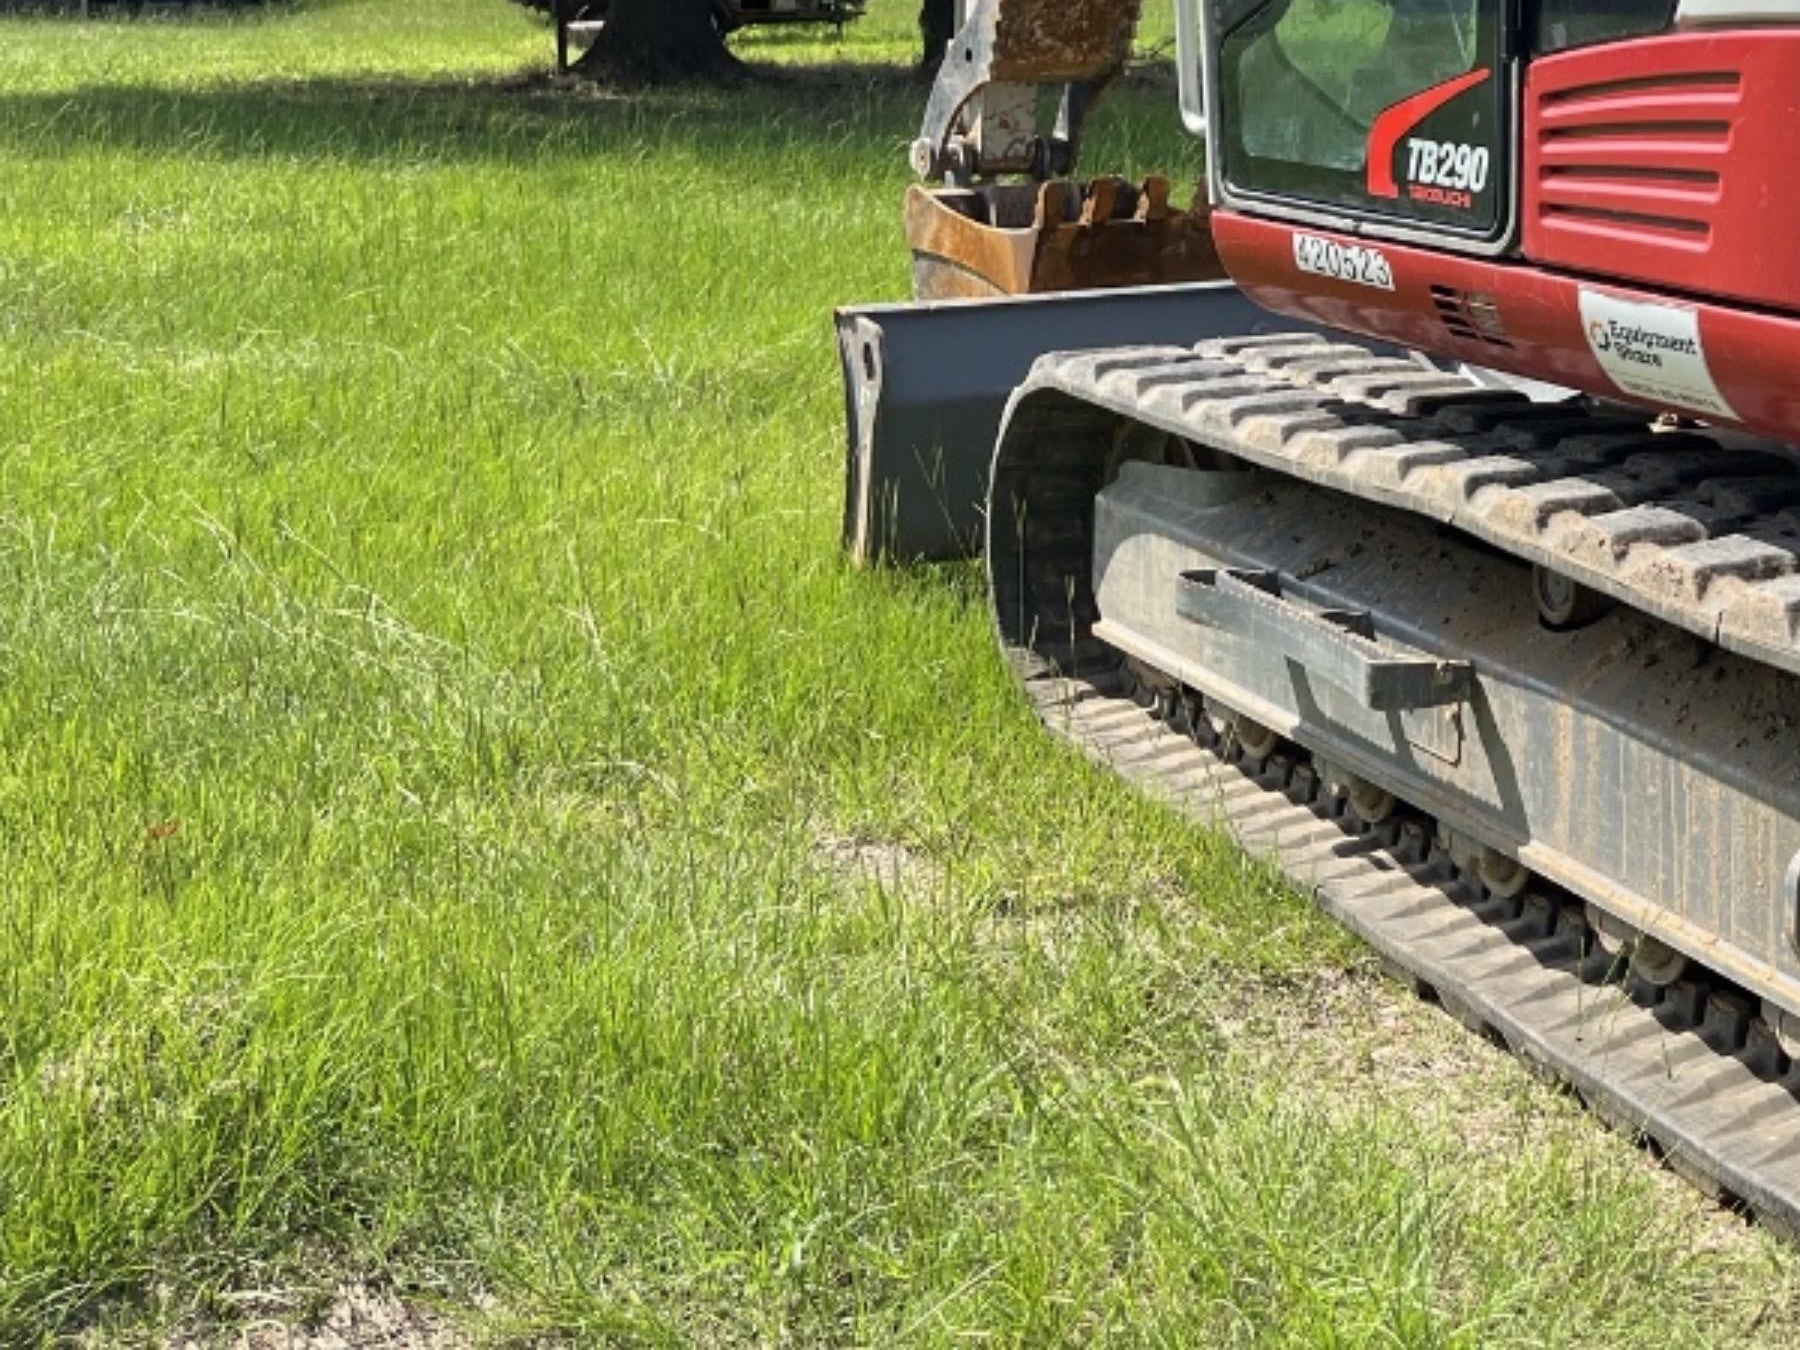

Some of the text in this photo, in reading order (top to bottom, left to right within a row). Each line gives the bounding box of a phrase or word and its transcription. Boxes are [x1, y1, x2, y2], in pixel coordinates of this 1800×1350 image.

[1406, 136, 1489, 193] TB290
[1298, 235, 1391, 286] 420523
[1607, 318, 1697, 355] Equipment
